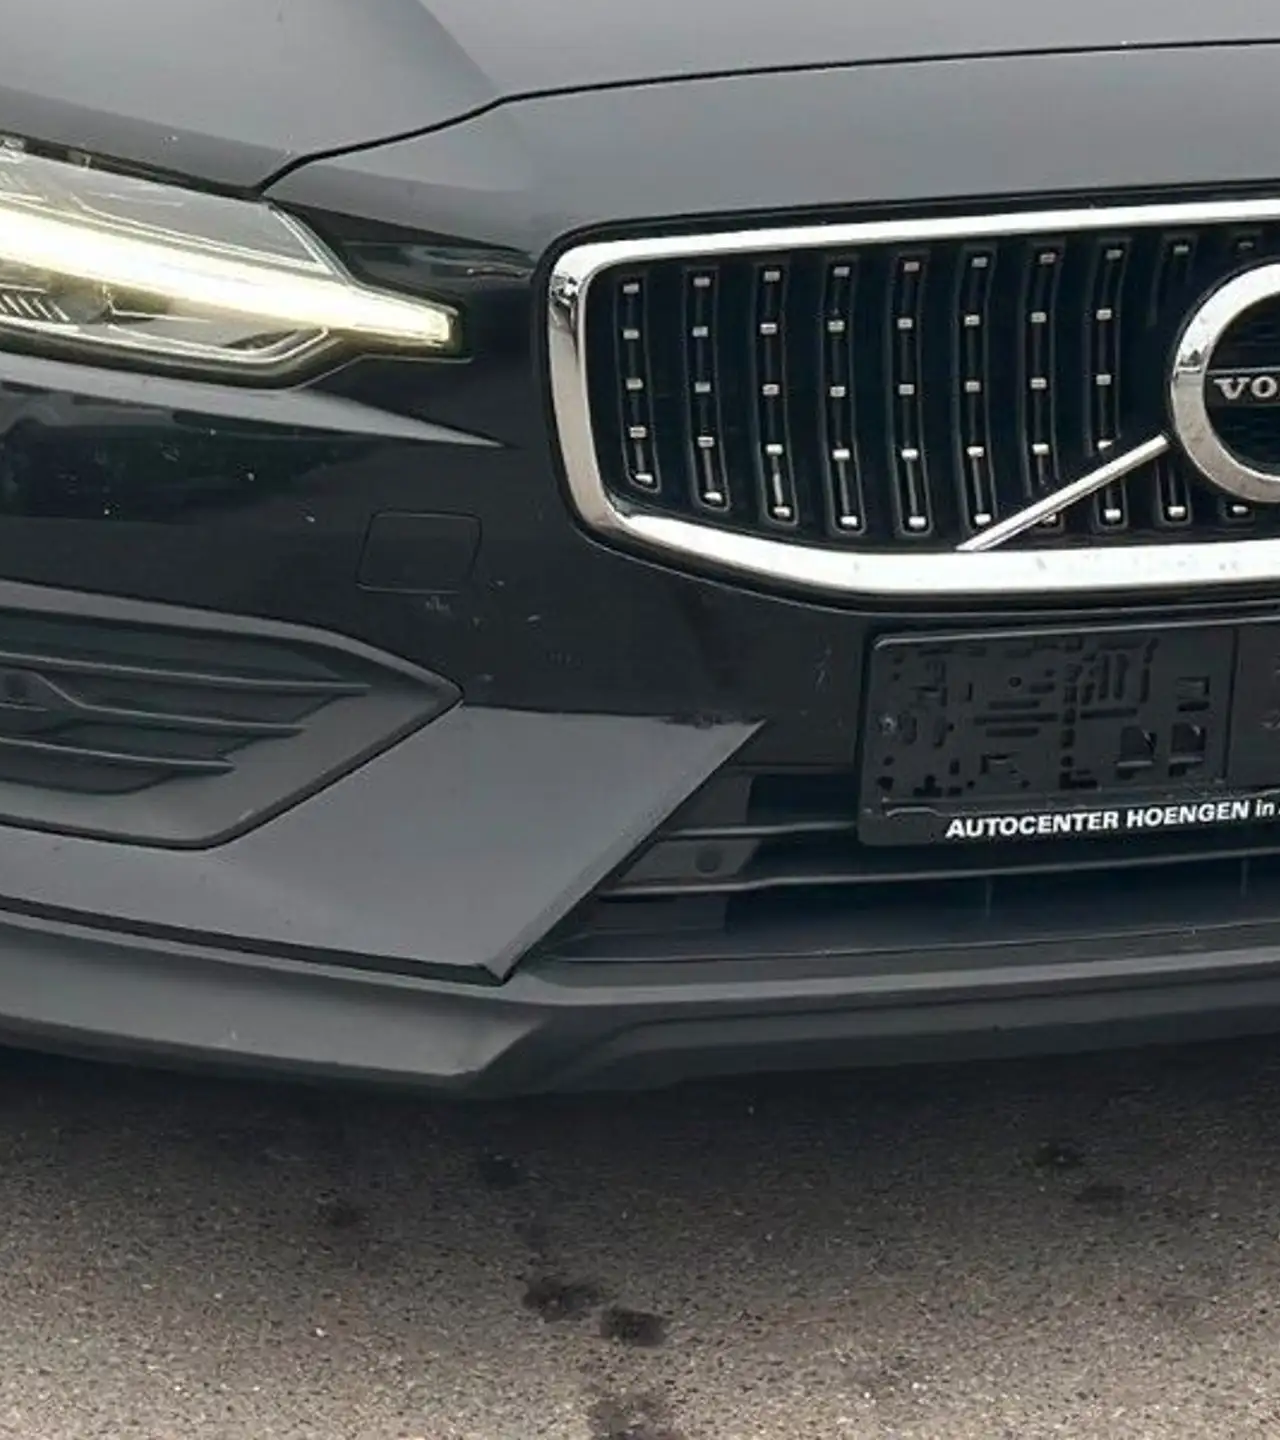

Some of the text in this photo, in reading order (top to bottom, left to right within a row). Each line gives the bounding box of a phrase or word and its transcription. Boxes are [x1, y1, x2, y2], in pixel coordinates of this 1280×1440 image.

[945, 810, 1119, 839] AUTOCENTER
[1126, 800, 1250, 828] HOENGEN
[1255, 799, 1275, 818] in
